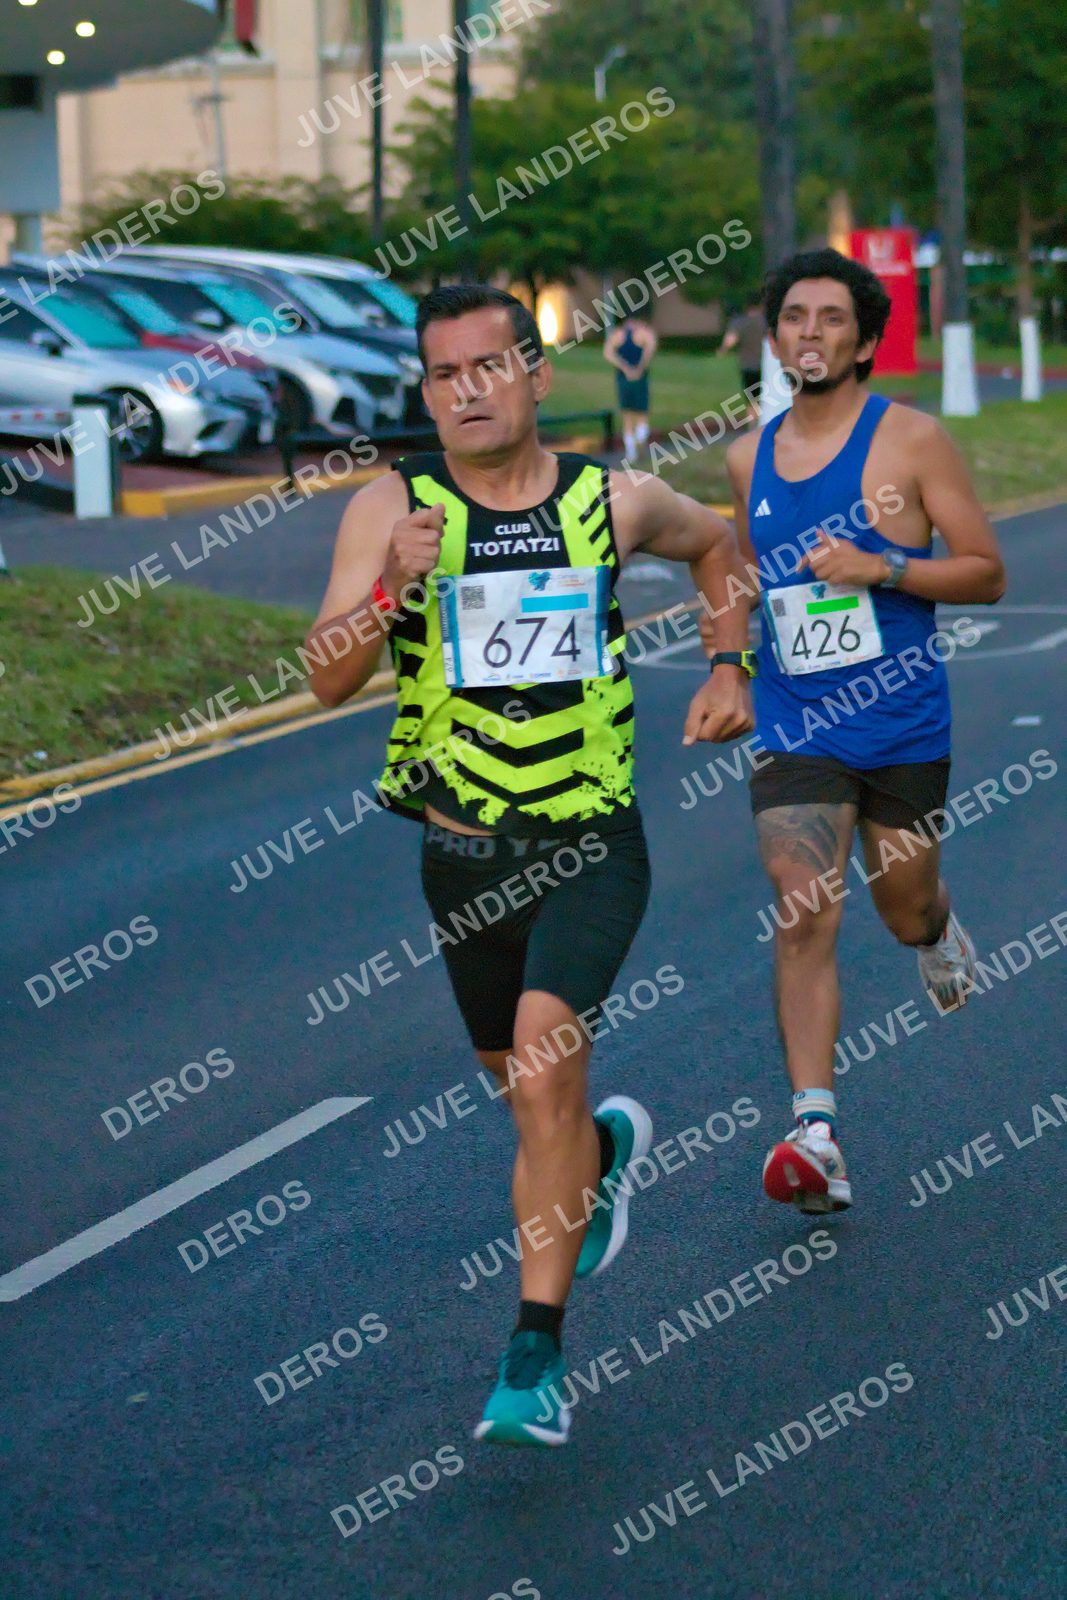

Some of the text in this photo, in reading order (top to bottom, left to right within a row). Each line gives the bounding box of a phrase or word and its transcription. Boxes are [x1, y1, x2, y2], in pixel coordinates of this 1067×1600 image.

[494, 522, 531, 536] CLUB
[470, 538, 560, 556] TOTATZI
[483, 615, 581, 668] 674
[791, 614, 860, 660] 426
